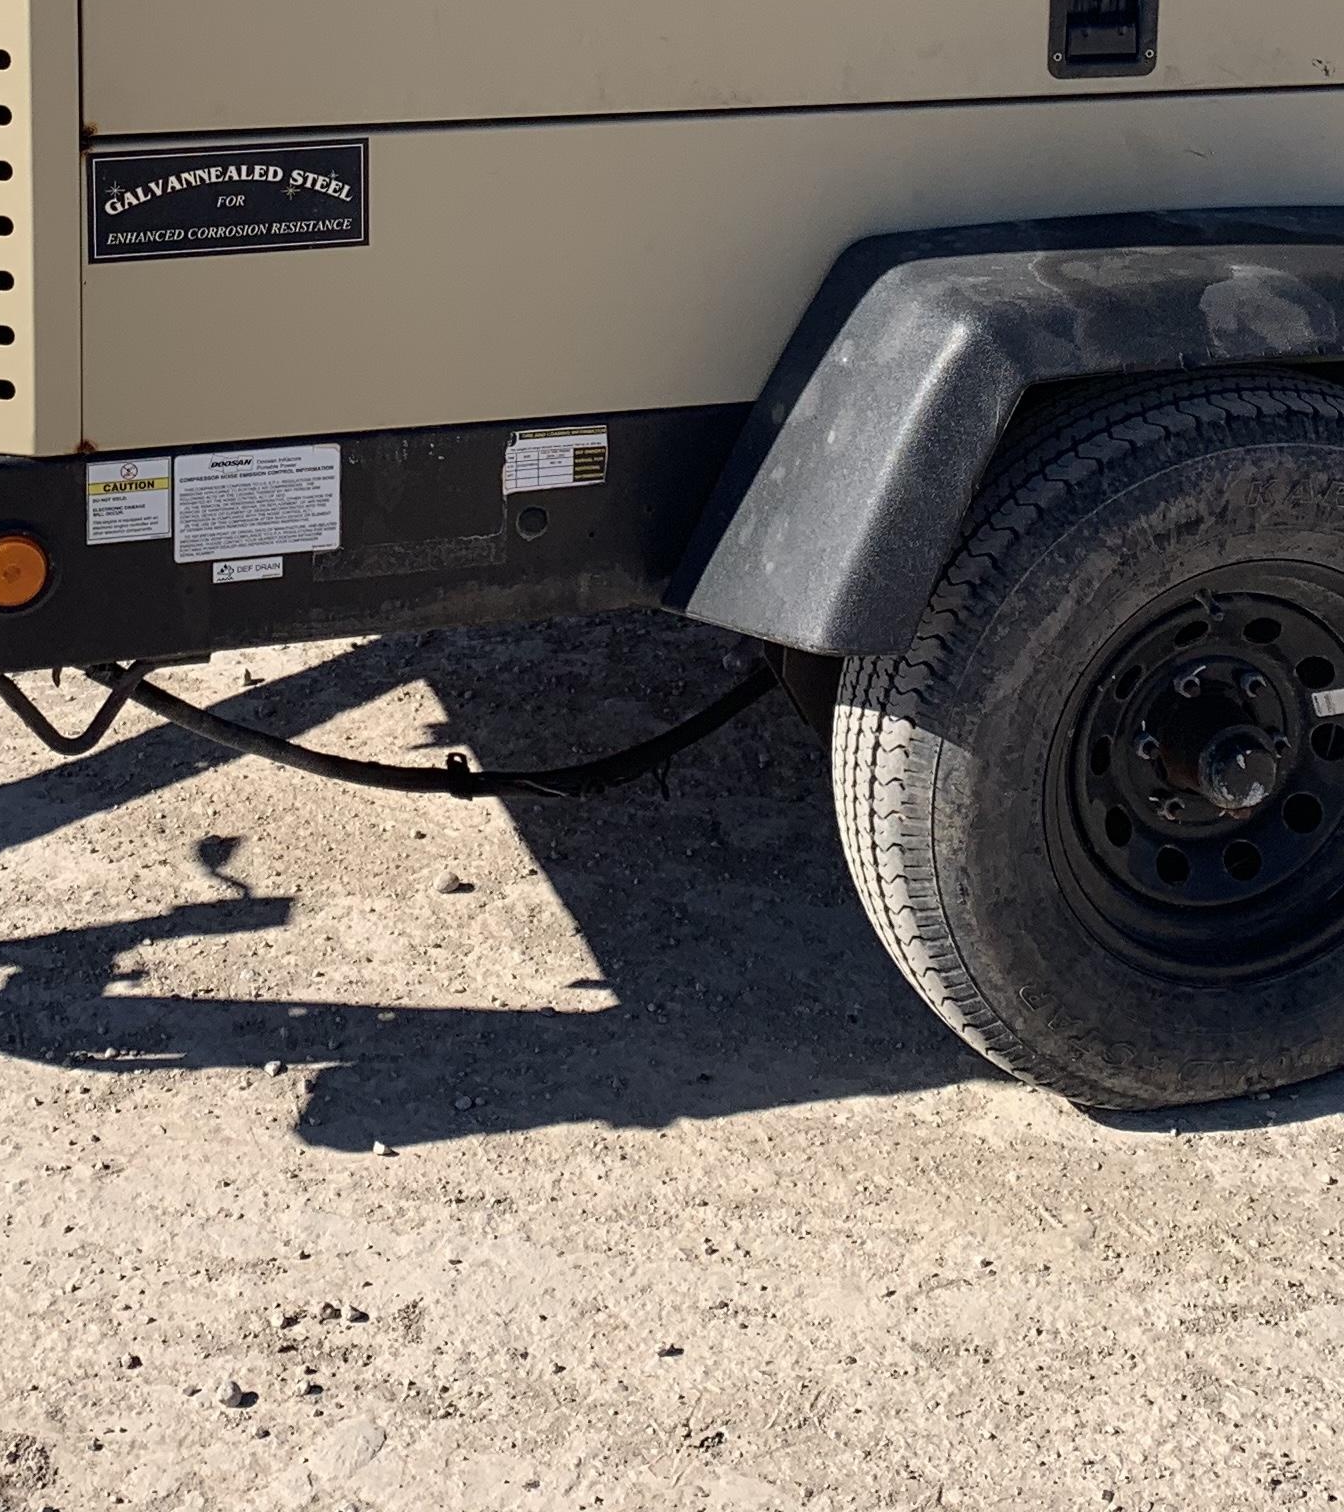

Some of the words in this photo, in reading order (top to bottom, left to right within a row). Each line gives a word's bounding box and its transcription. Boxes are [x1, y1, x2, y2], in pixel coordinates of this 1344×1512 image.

[104, 165, 284, 215] GALVANNEALED
[289, 169, 353, 202] STEEL
[216, 194, 246, 208] FOR
[106, 228, 185, 245] ENHANCED
[187, 223, 269, 240] CORROSION
[270, 218, 353, 235] RESISTANCE
[210, 458, 253, 469] DOOSAN
[179, 474, 220, 483] COMPRESSOR
[239, 470, 266, 478] EMISSION
[267, 467, 295, 476] CONTROL
[103, 480, 155, 492] CAUTION
[237, 564, 254, 574] DEF
[255, 562, 281, 571] DRAIN
